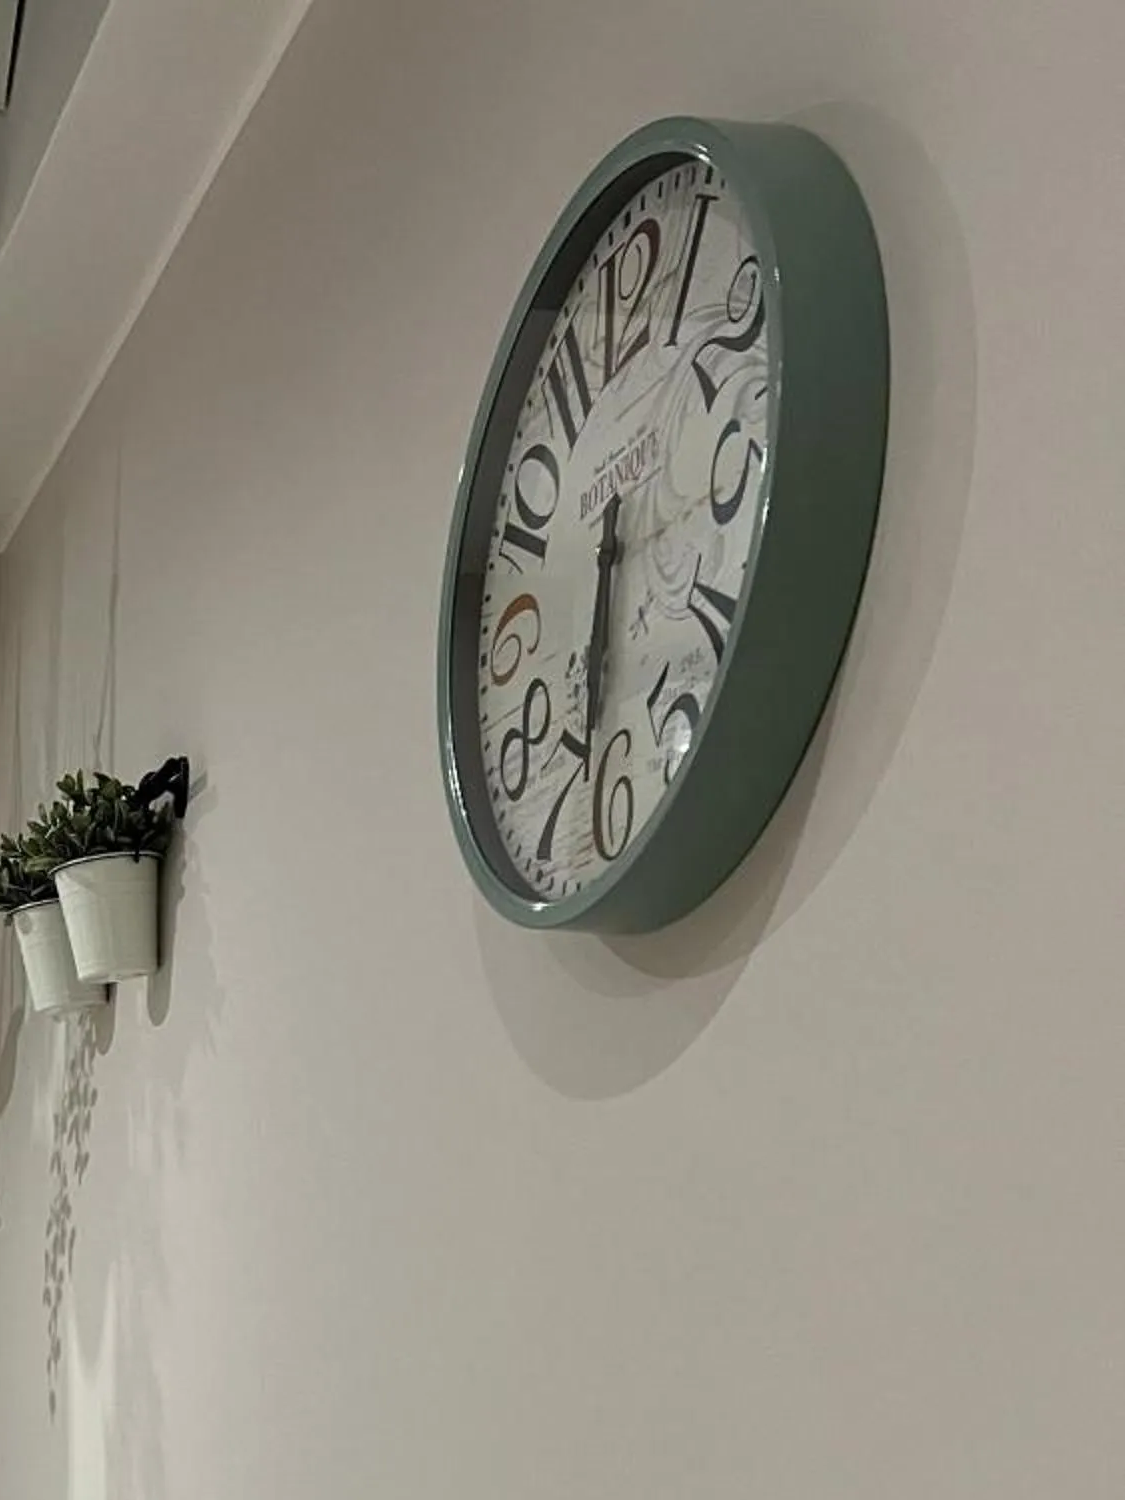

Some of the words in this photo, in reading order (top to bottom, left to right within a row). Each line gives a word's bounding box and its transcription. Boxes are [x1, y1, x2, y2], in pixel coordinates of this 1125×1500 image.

[592, 218, 661, 393] 12
[663, 193, 720, 348] 1
[691, 254, 766, 415] 2
[540, 301, 596, 463] 11
[498, 443, 561, 575] 10
[500, 676, 552, 802] 8
[646, 660, 702, 786] 5
[535, 727, 592, 862] 7
[592, 728, 635, 861] 6
